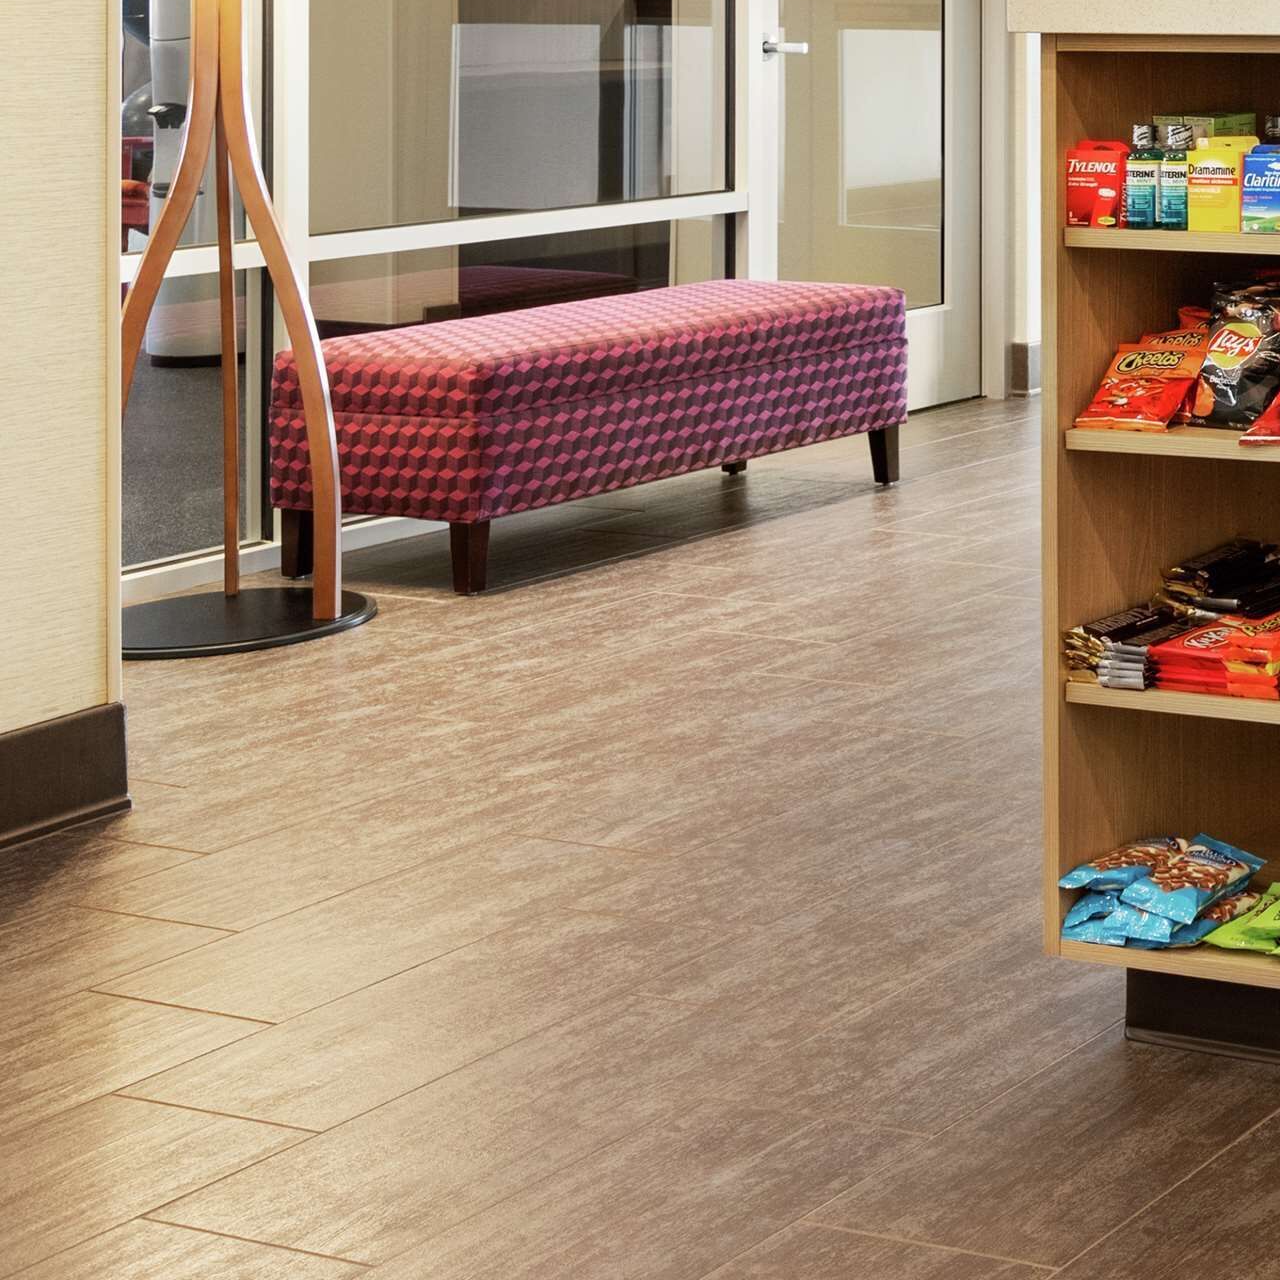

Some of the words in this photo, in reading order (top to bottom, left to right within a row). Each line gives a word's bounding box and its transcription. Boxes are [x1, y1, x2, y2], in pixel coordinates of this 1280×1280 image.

[1068, 159, 1118, 174] TYLENOL
[1188, 163, 1236, 176] Dramamine
[1210, 330, 1256, 356] Lay's
[1117, 350, 1184, 373] Cheetos
